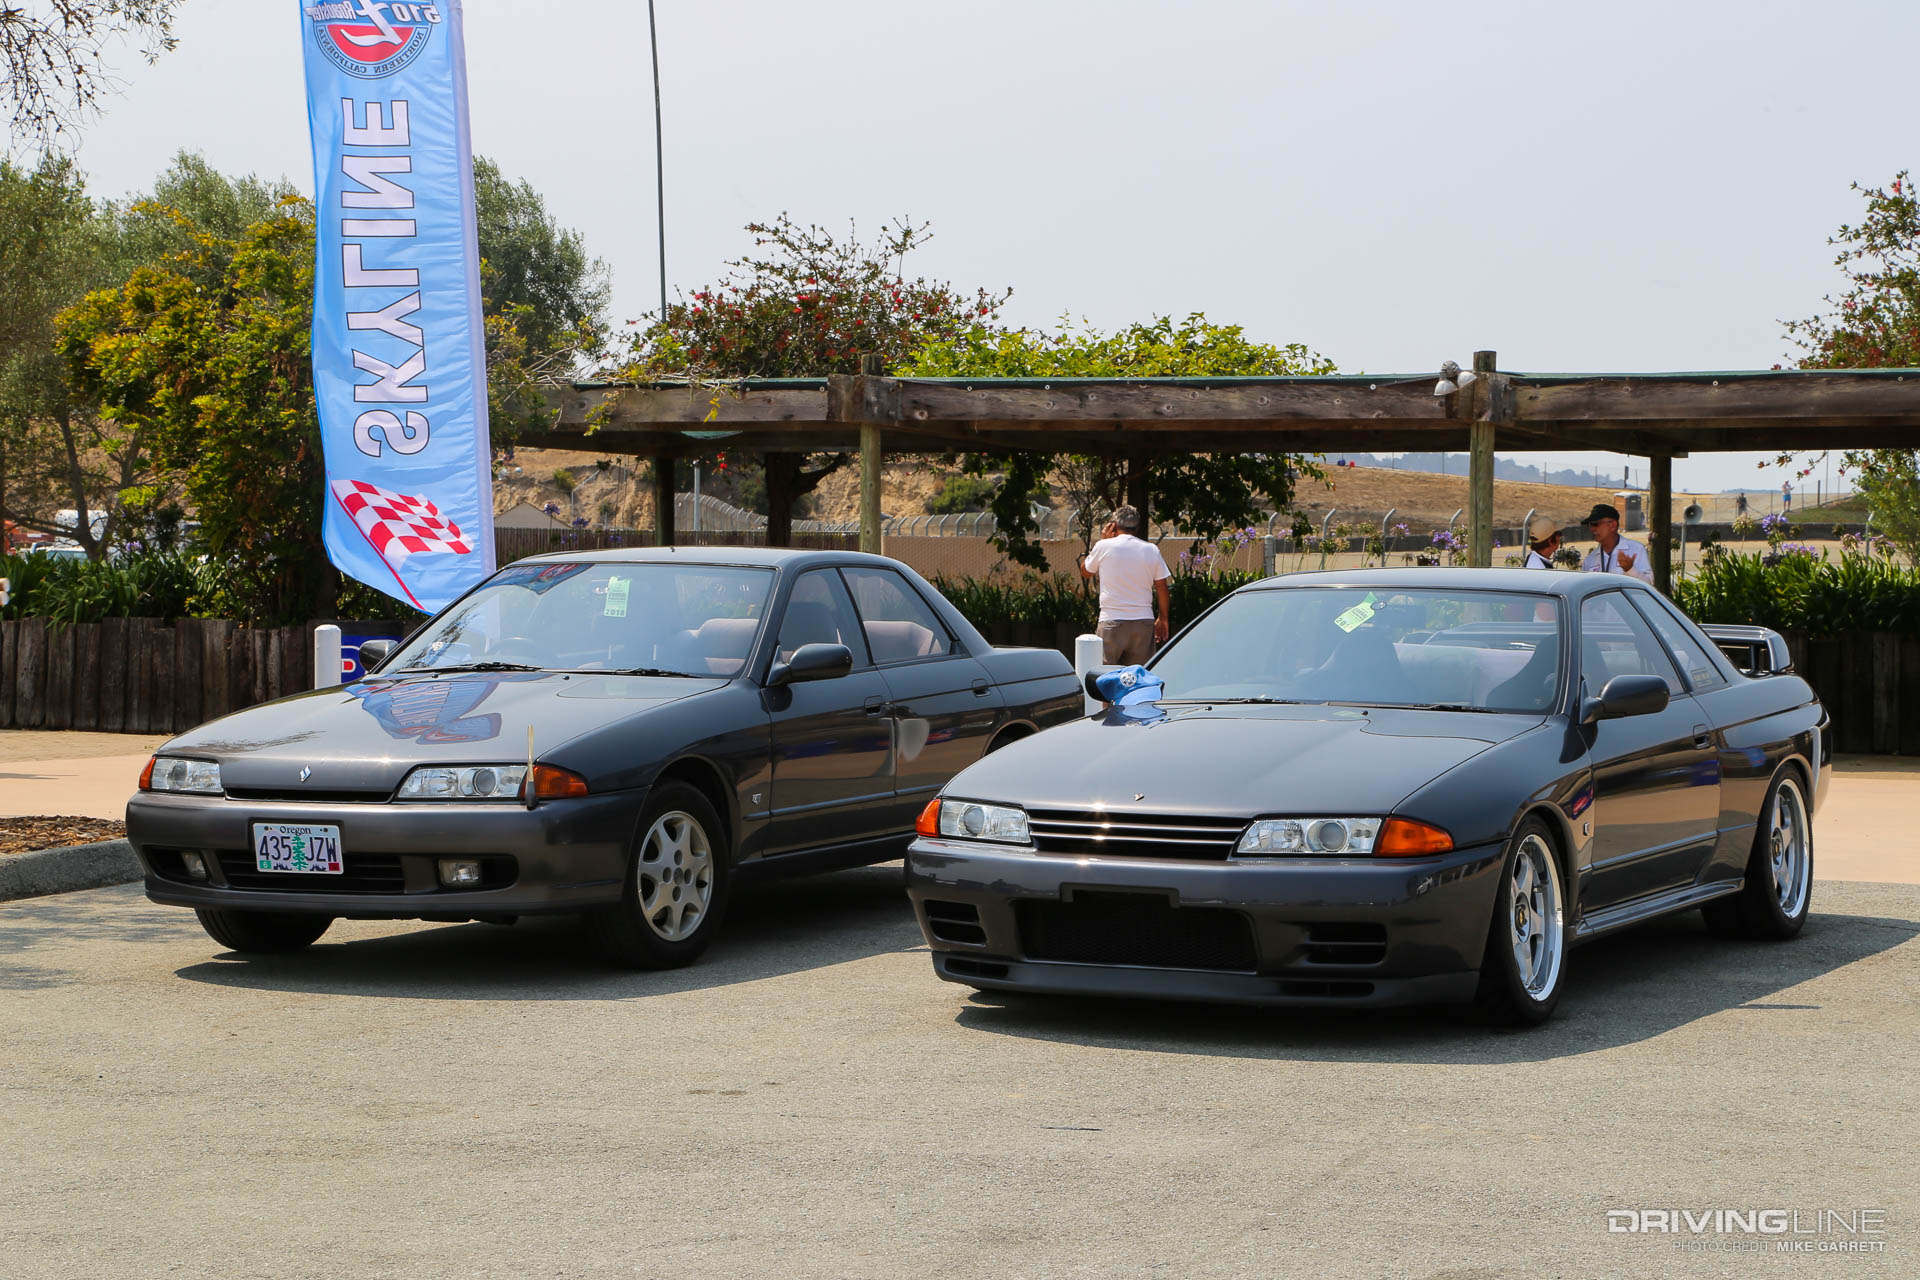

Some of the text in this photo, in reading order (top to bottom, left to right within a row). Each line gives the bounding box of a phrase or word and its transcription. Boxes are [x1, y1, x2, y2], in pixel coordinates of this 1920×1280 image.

[279, 825, 312, 836] Oregon
[259, 835, 337, 862] 435 JZW
